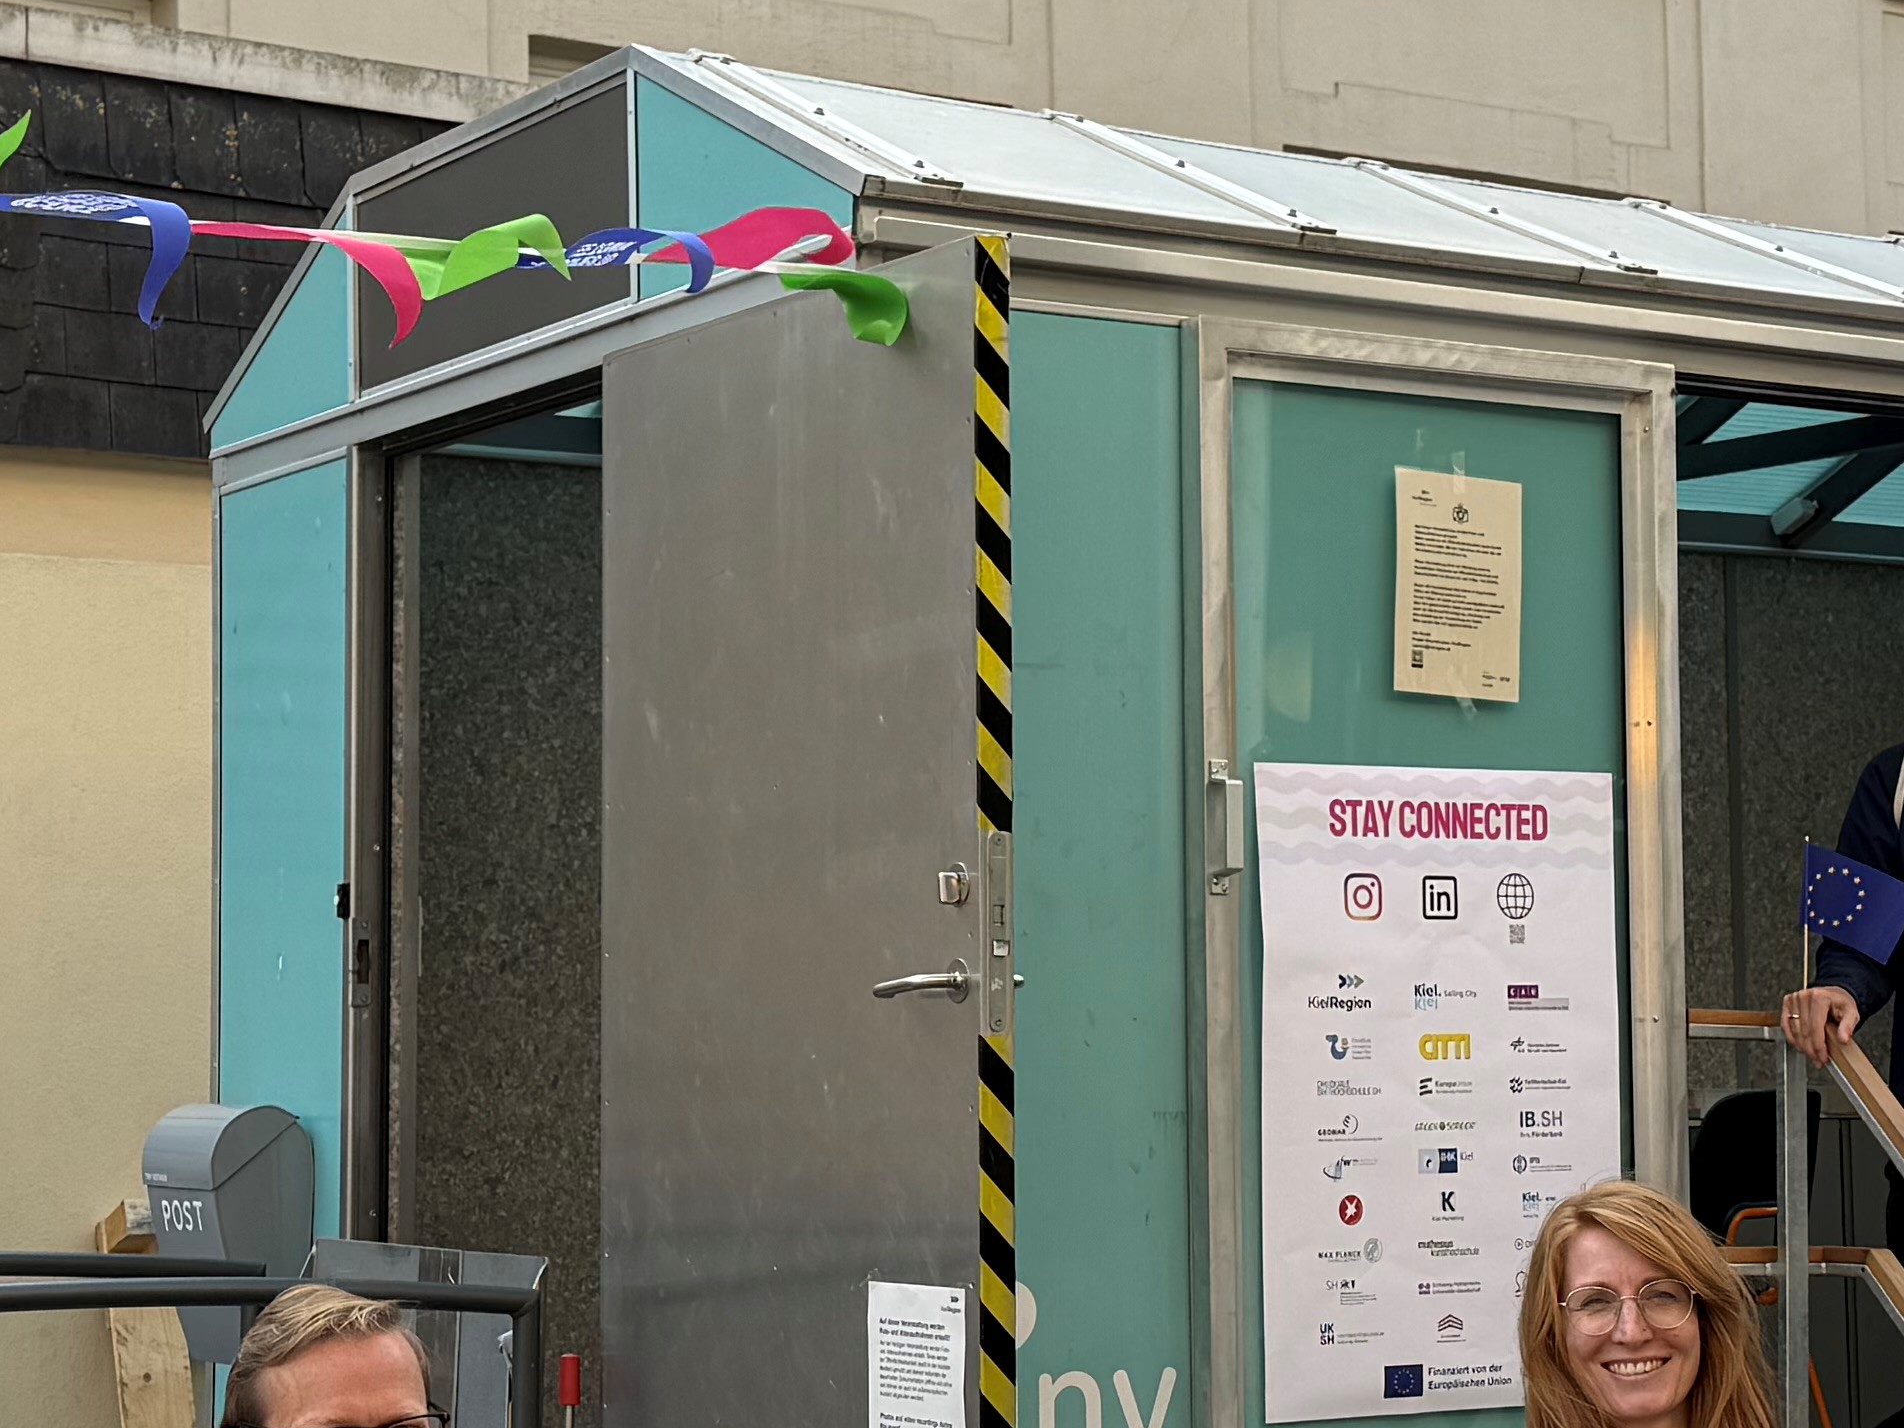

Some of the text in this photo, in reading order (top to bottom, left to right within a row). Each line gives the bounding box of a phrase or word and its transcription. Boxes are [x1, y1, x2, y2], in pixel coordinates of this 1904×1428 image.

[1328, 799, 1549, 841] STAY CONNECTED
[1308, 995, 1372, 1012] KielRegion
[161, 1199, 202, 1232] POST
